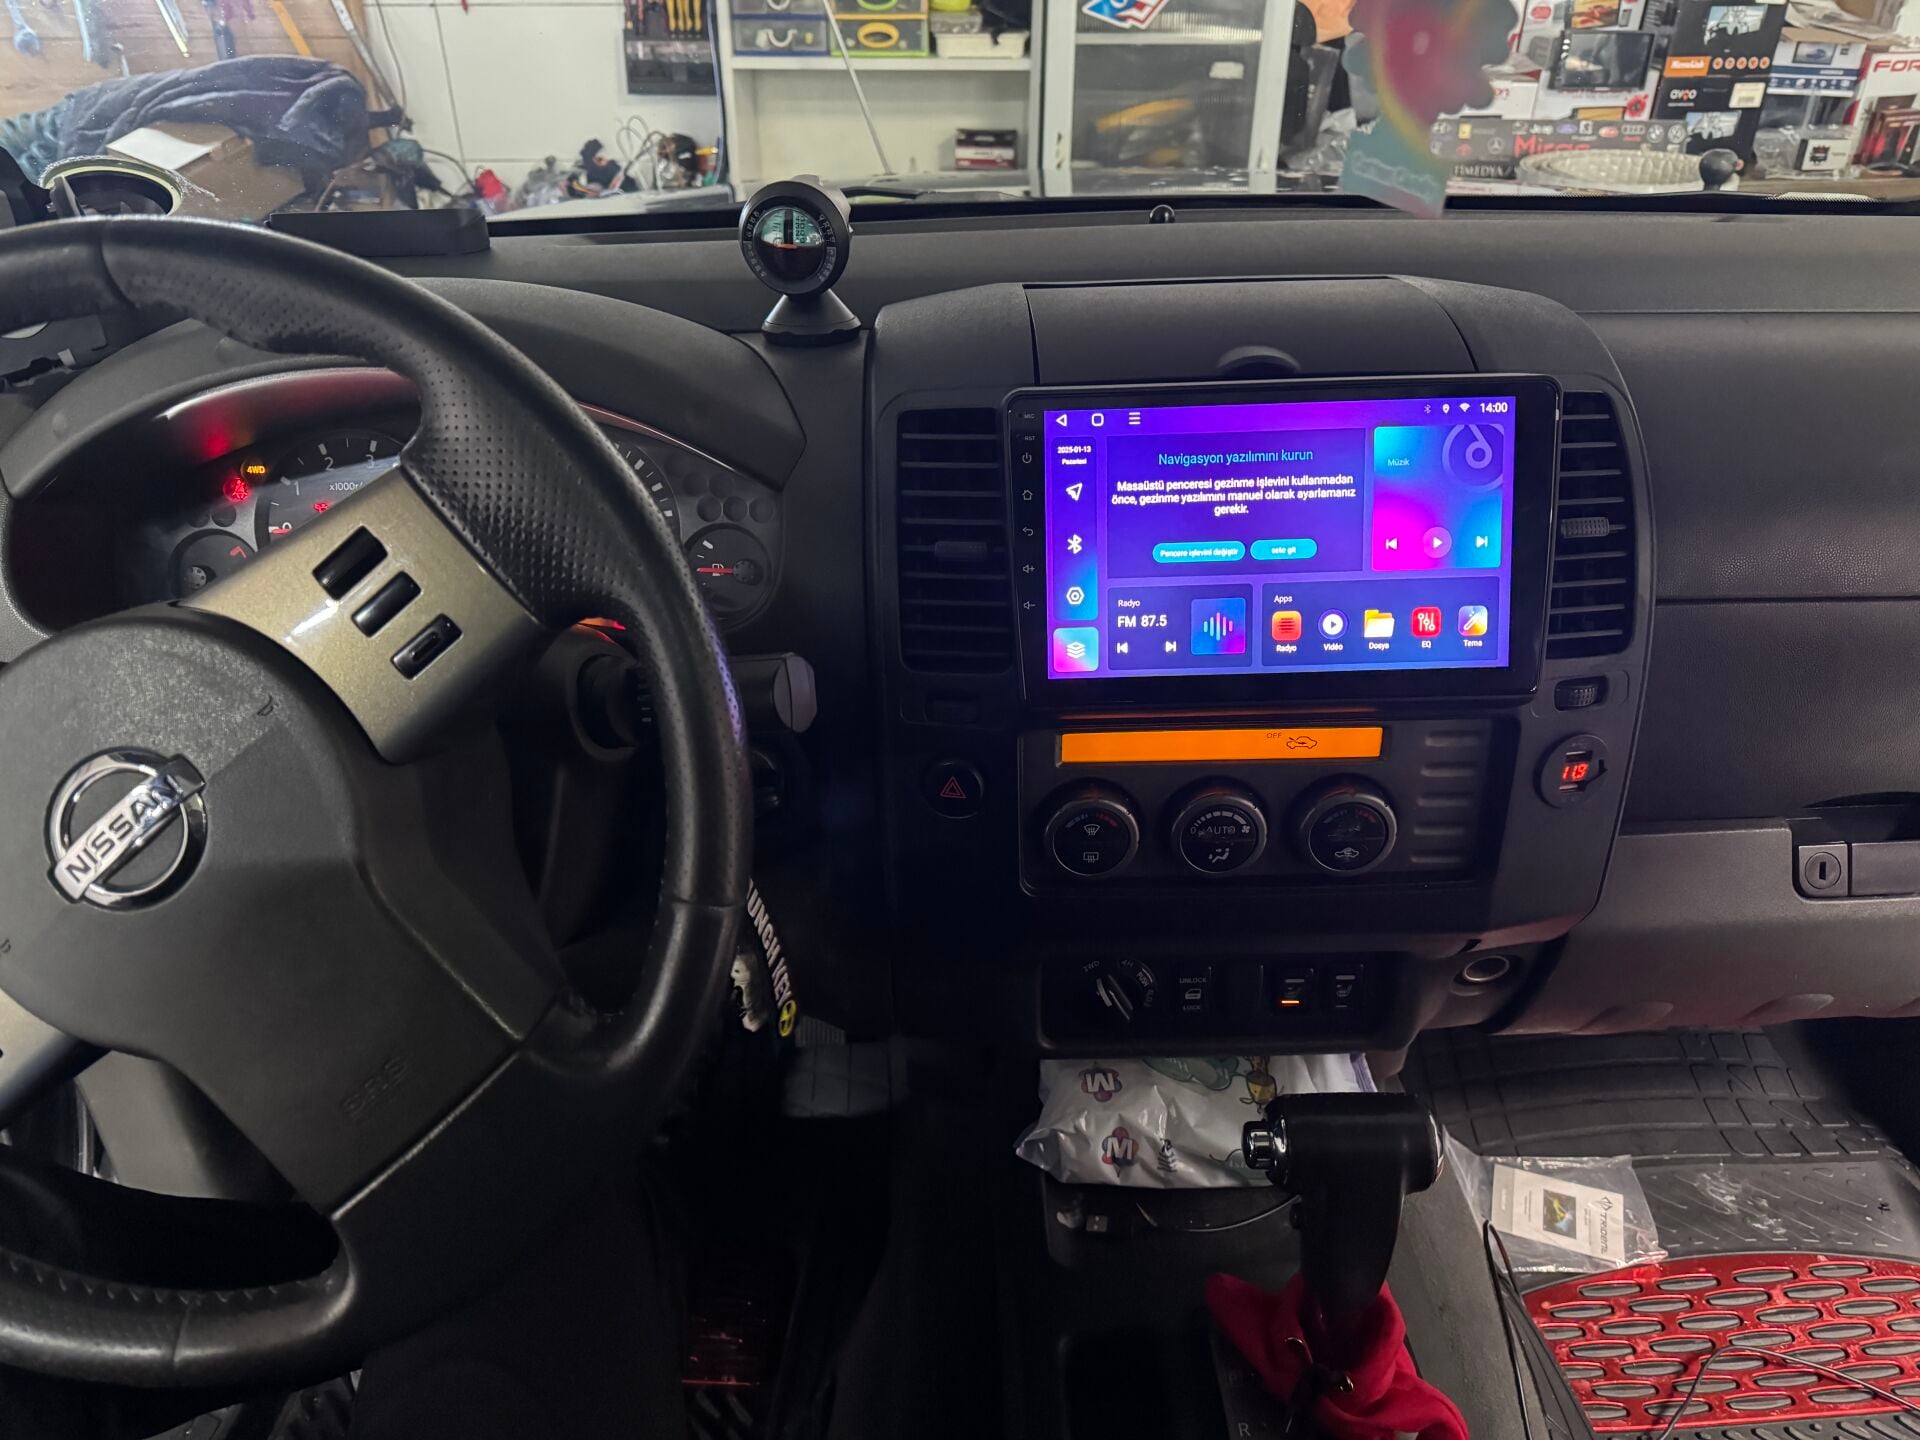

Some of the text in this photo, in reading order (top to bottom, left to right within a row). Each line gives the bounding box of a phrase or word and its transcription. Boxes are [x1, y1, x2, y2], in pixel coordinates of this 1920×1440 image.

[1480, 402, 1508, 413] 14:00
[324, 457, 335, 471] 2
[366, 454, 375, 468] 3
[1158, 450, 1314, 466] Navigasyon yazılımını kurun
[1387, 457, 1410, 466] Müzik
[247, 466, 266, 474] 4WD
[294, 481, 300, 496] 1
[1117, 474, 1353, 492] Masaüstü penceresi gezinme işlevini kullanmadan
[1112, 488, 1357, 506] önce, gezinme yazılımını manuel olarak ayarlamanız
[1214, 504, 1249, 517] gerekir.
[1118, 599, 1141, 608] Radyo
[1273, 594, 1293, 604] Apps
[1117, 614, 1168, 627] FM 87.5
[1276, 644, 1297, 653] Radyo
[1421, 640, 1432, 649] EQ
[1463, 639, 1483, 648] Tema
[65, 774, 184, 884] NISSAN
[1238, 1422, 1251, 1437] R
